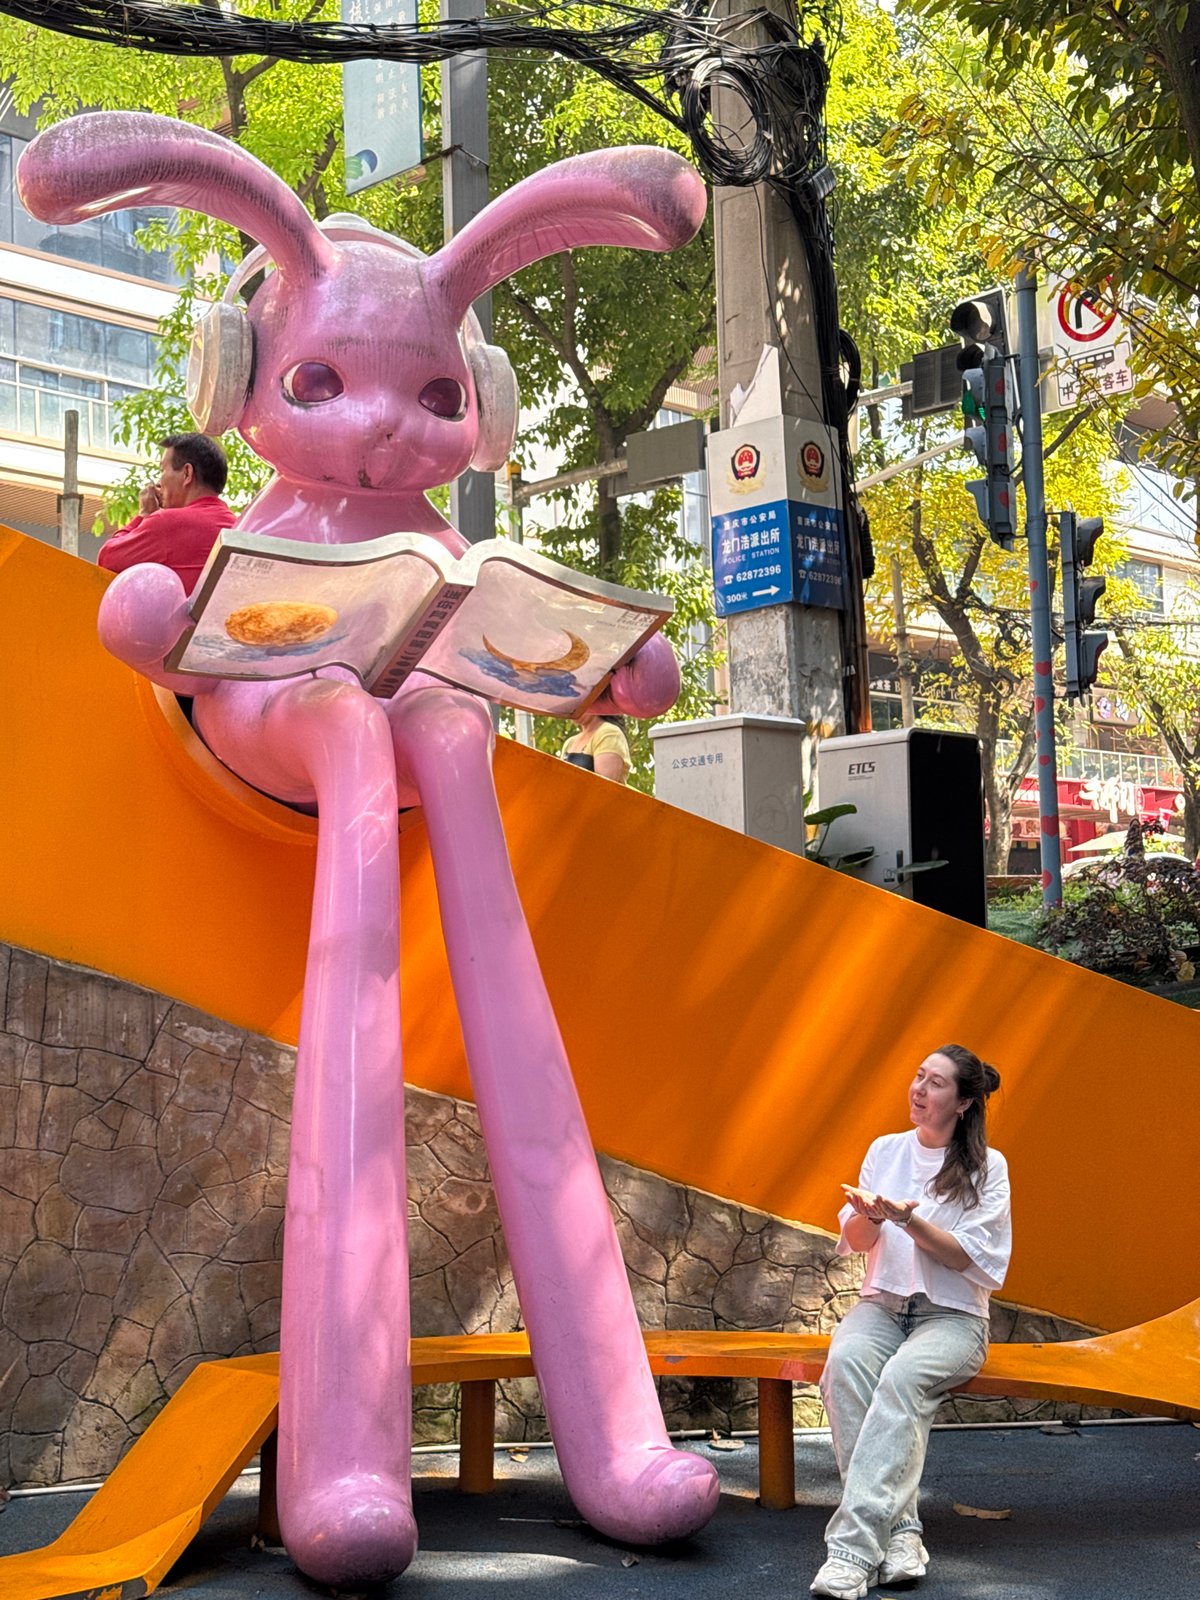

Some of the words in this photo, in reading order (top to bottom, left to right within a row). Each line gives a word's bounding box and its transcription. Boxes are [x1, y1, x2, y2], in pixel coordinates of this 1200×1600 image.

[723, 510, 777, 531] 重庆市公安局
[721, 527, 780, 555] 龙门浩派出所
[723, 553, 746, 565] POLICE
[751, 546, 780, 559] STATION
[736, 564, 781, 582] 62872396
[672, 753, 723, 769] 公安交通专用
[848, 761, 876, 775] ETCS
